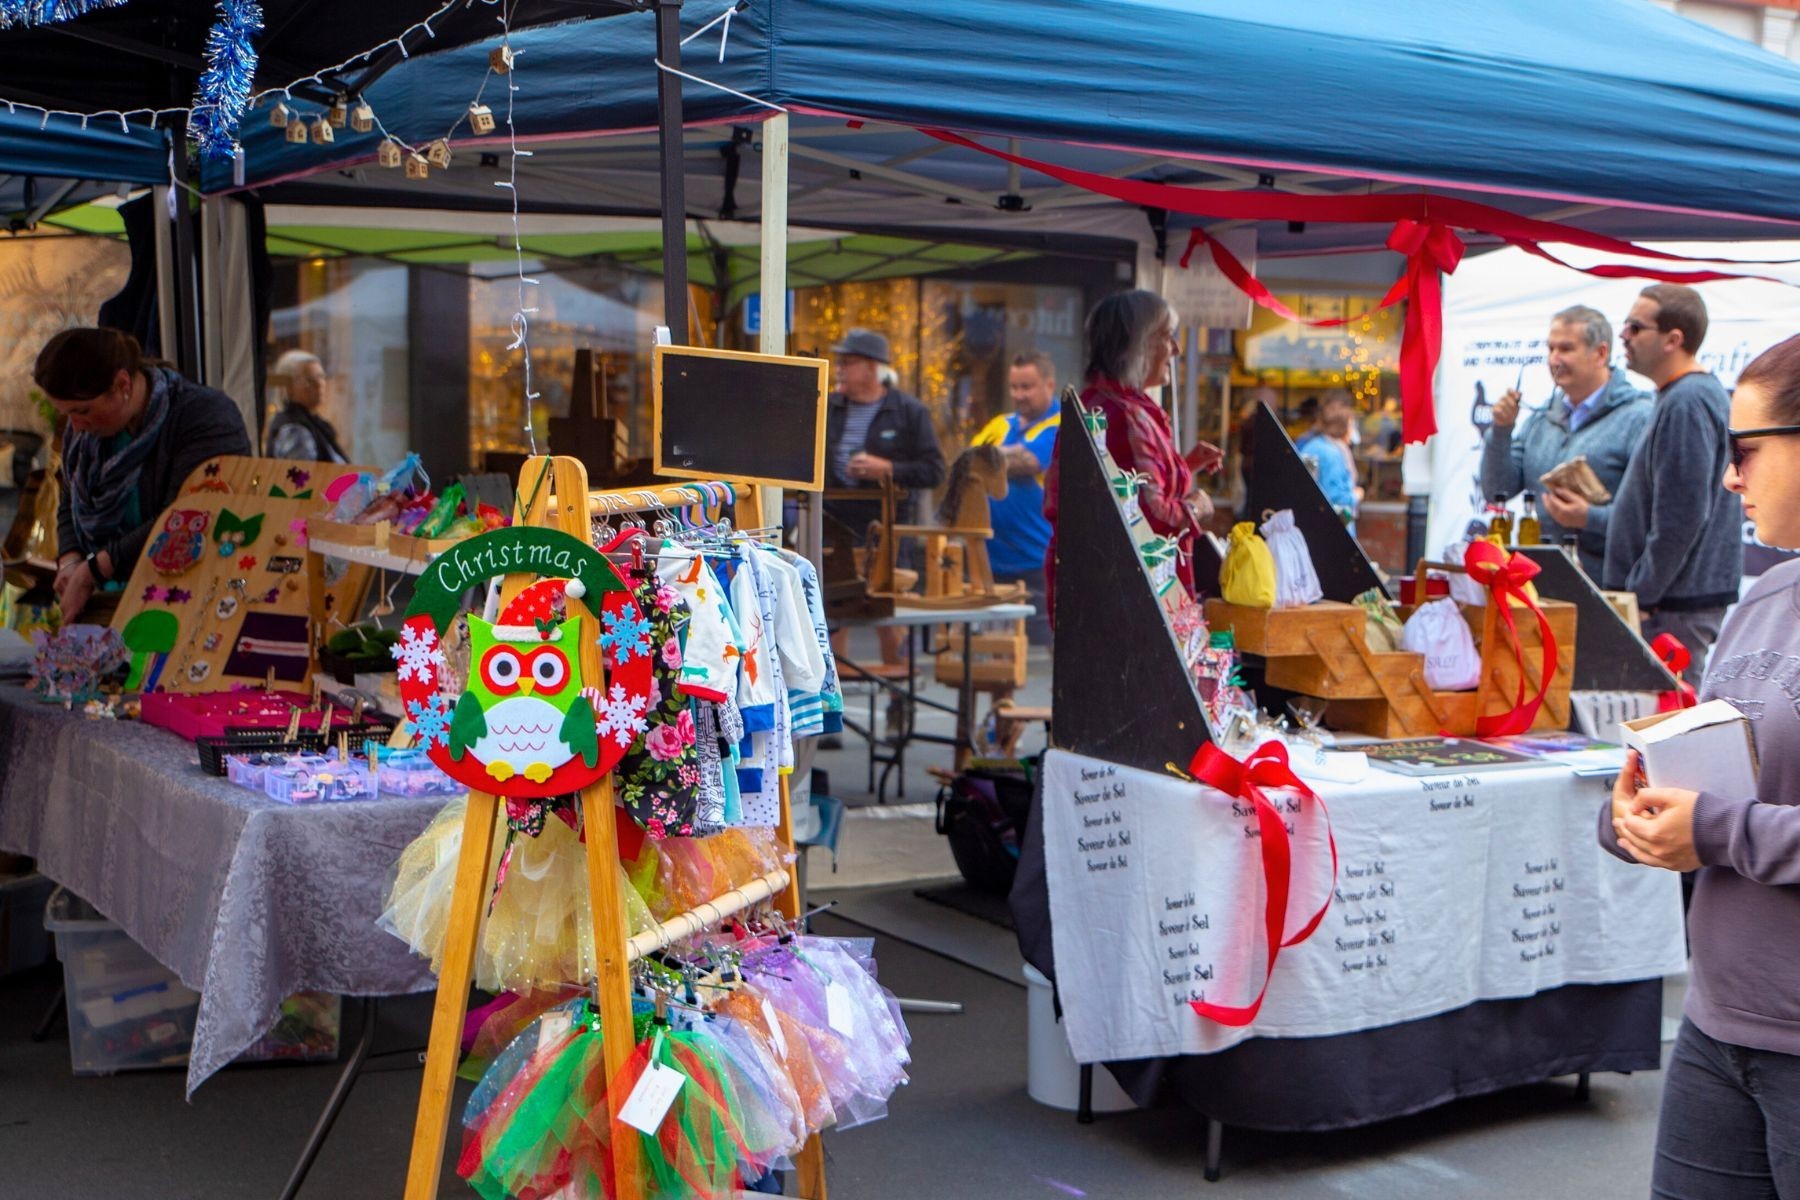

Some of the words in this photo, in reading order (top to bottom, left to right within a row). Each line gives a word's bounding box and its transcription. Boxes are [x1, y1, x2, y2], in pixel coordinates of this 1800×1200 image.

[438, 540, 587, 592] Christmas
[1232, 801, 1258, 818] Save
[1286, 798, 1301, 813] Sel
[1192, 914, 1209, 929] Sel
[1194, 964, 1213, 980] Sel
